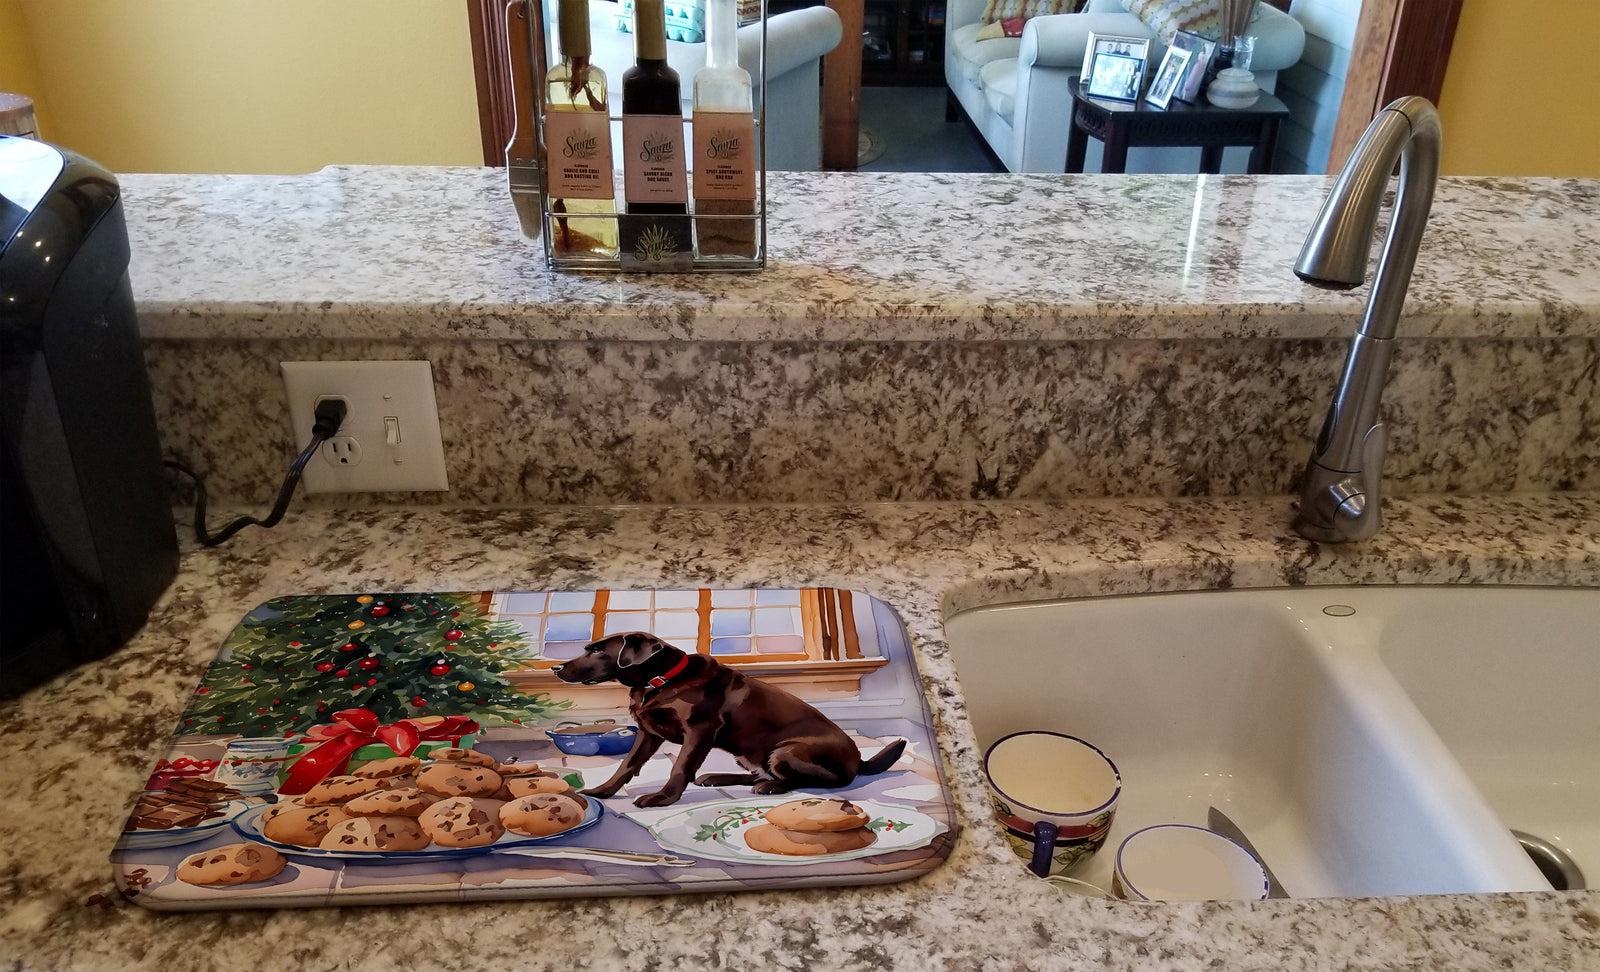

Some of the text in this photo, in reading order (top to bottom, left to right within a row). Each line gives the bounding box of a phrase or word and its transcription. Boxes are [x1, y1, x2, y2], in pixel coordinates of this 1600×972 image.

[563, 136, 597, 158] Sauza
[640, 140, 673, 162] Sauza
[707, 136, 740, 159] Sauza
